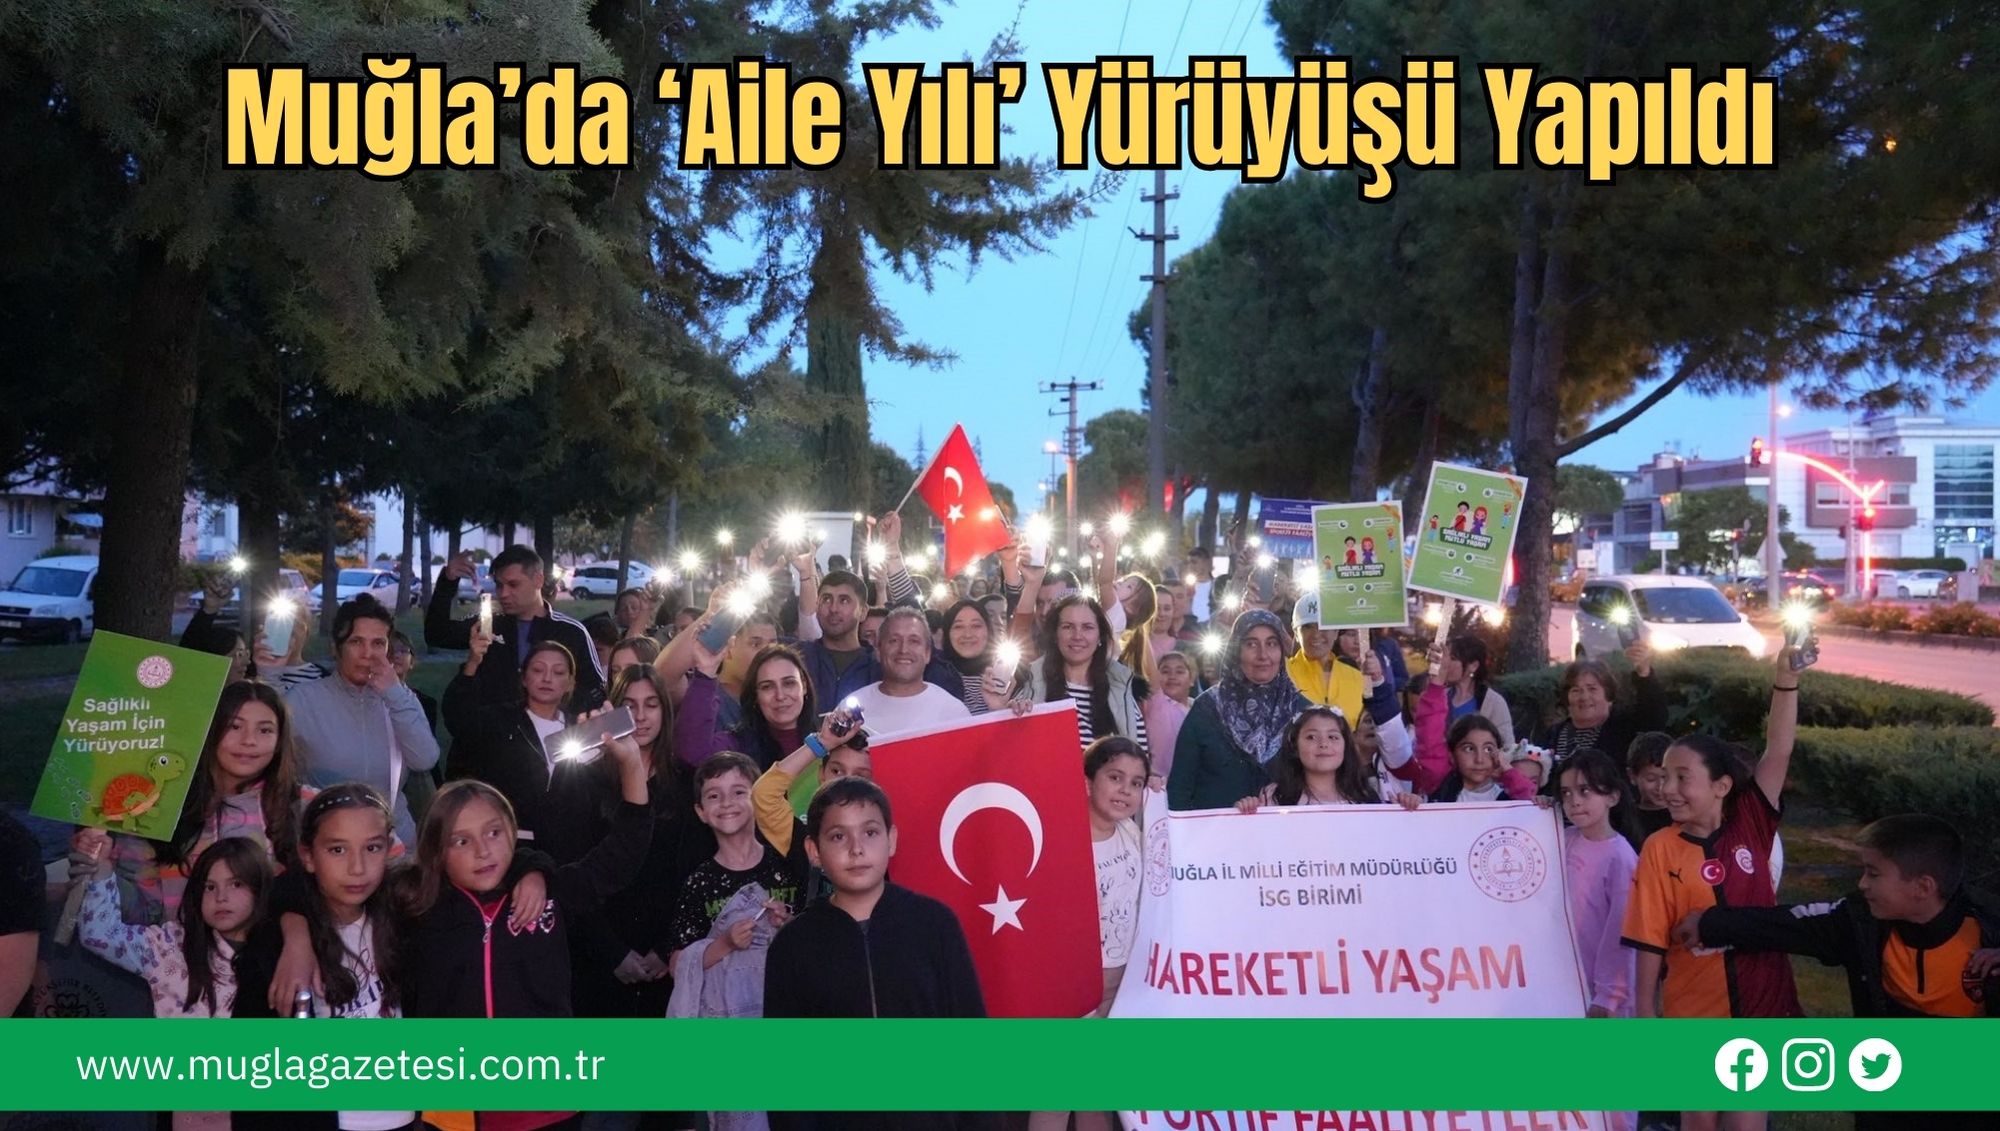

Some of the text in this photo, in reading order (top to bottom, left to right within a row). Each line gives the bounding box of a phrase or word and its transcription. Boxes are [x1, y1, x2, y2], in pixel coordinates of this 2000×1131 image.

[66, 713, 165, 734] Yaşam İçin
[63, 735, 164, 753] Yürüyoruz!
[1170, 857, 1458, 882] UĞLA İL MİLLİ EĞİTİM MÜDÜRLÜĞÜ
[1259, 883, 1363, 907] İSG BİRİMİ
[1144, 937, 1527, 1003] HAREKETLİ YAŞAM
